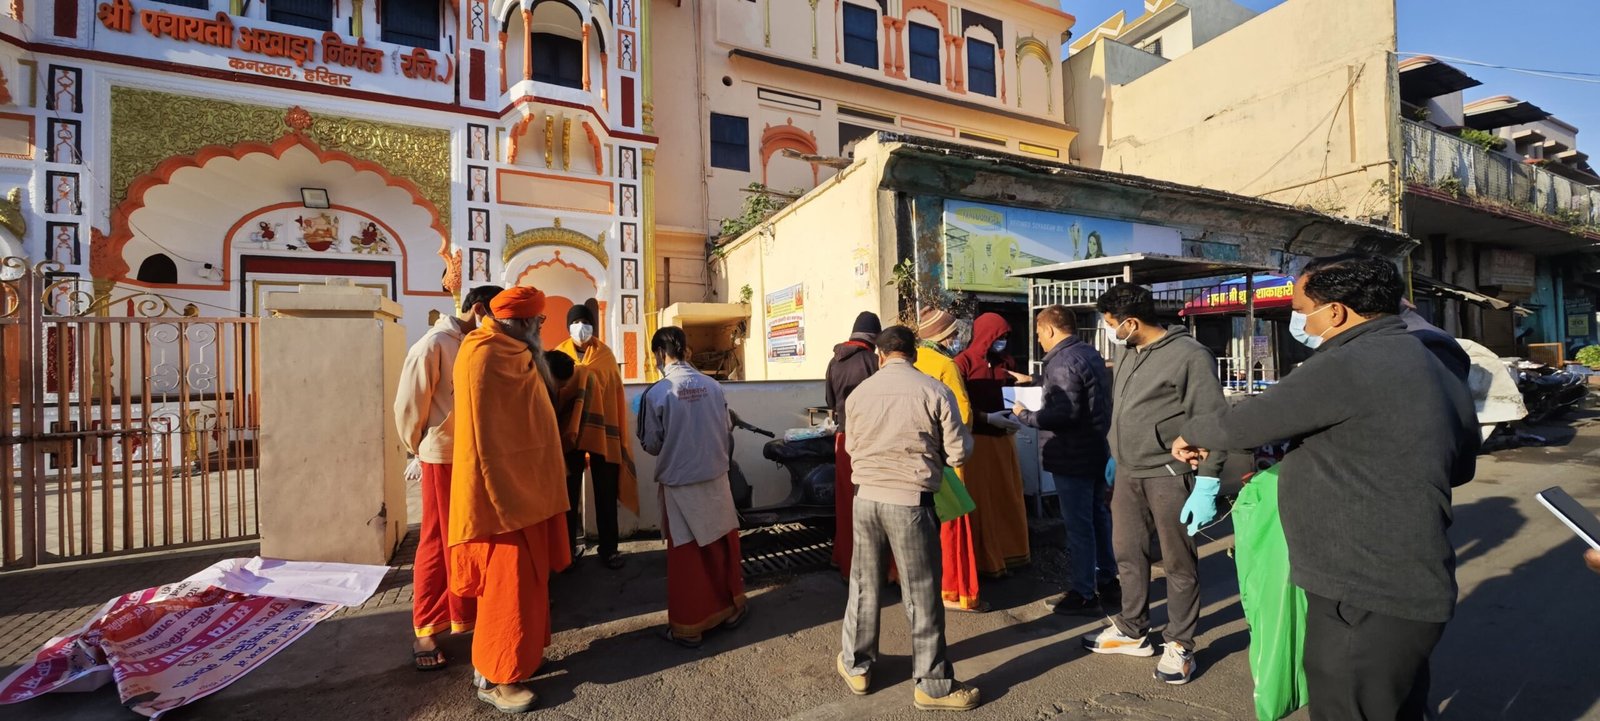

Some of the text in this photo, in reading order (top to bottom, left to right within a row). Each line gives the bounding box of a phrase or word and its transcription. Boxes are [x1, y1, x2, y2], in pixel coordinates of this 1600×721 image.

[97, 0, 134, 33] श्री
[237, 26, 316, 67] अखाड़ा
[321, 31, 385, 74] निर्मल
[228, 57, 353, 87] कनखल, हरिद्वार
[206, 605, 253, 638] समय
